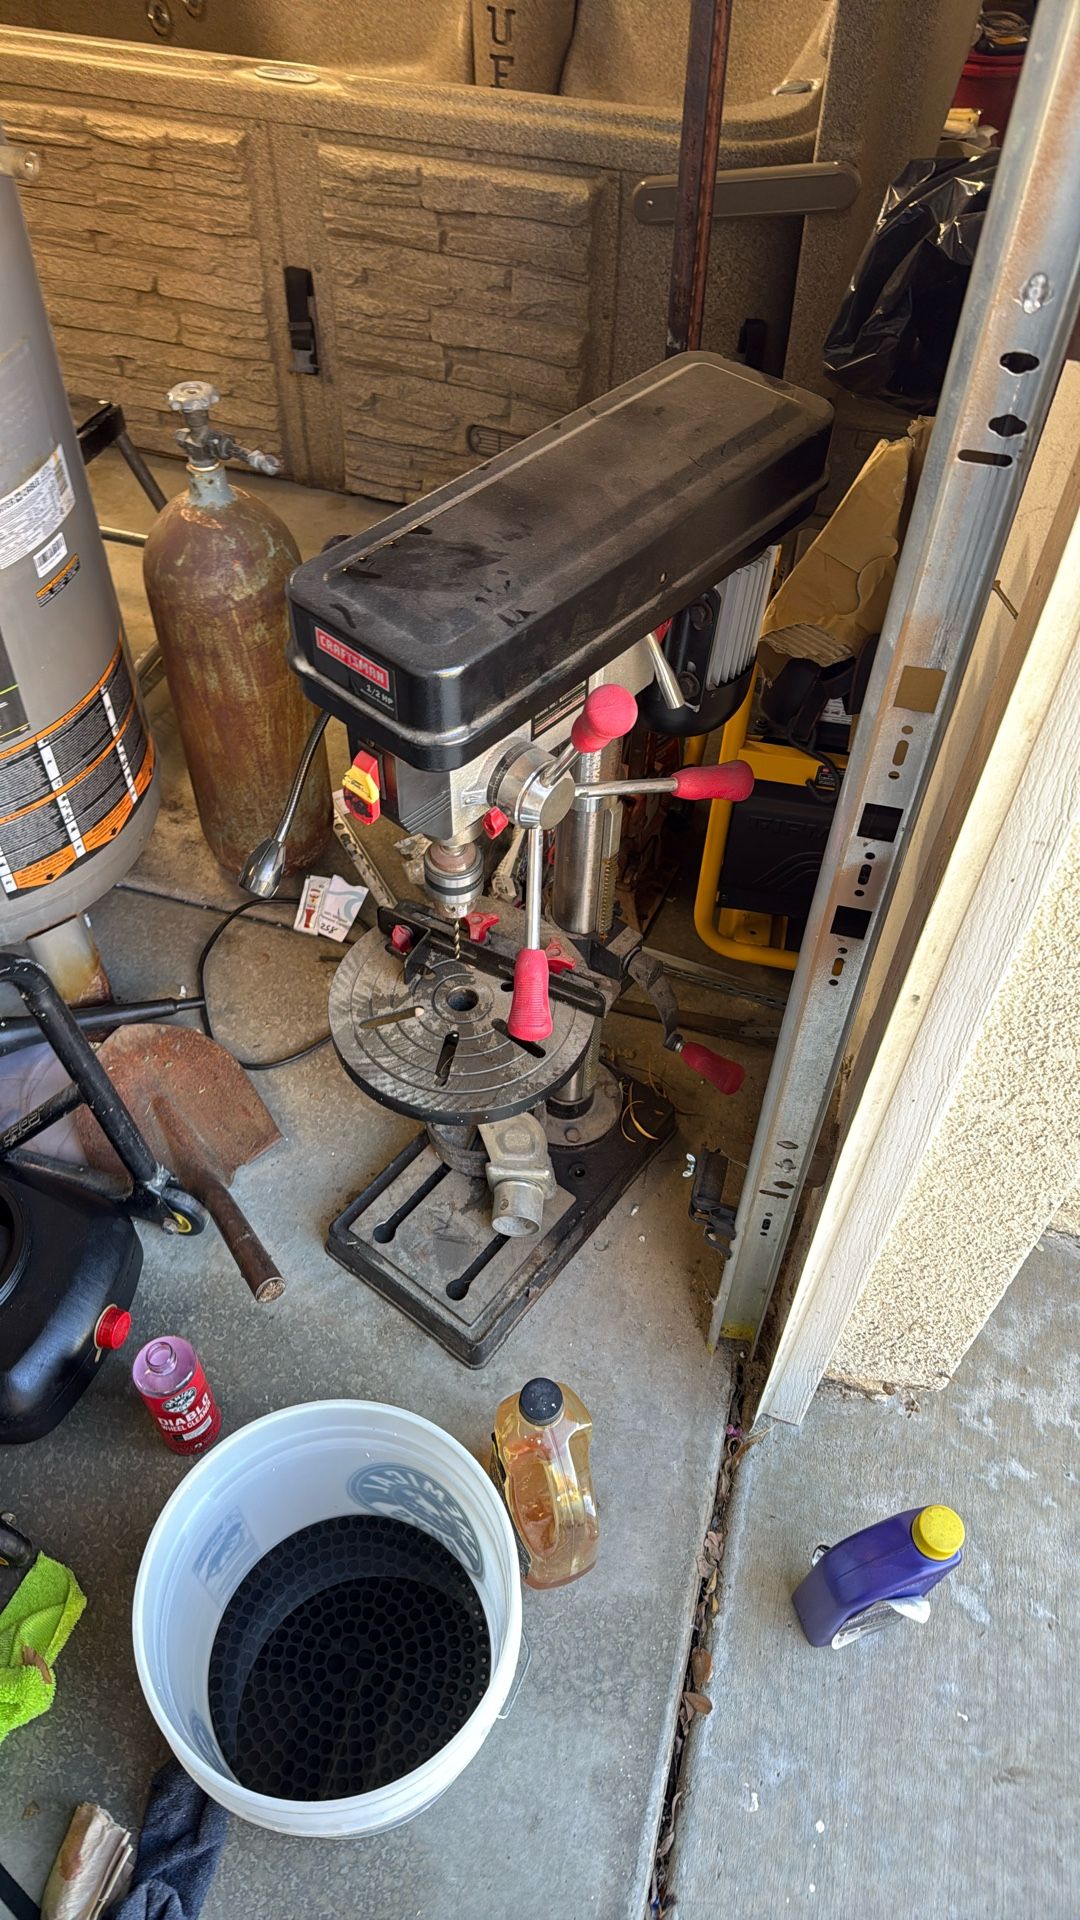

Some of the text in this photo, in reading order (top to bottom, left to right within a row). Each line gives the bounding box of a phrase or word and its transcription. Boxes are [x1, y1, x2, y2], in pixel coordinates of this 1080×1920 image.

[319, 634, 385, 684] CRAFTSMAN
[366, 684, 381, 699] 1/2
[381, 693, 394, 705] HP
[158, 1392, 209, 1427] DIABLO
[161, 1424, 187, 1432] WHEEL
[187, 1399, 212, 1428] CLEANER
